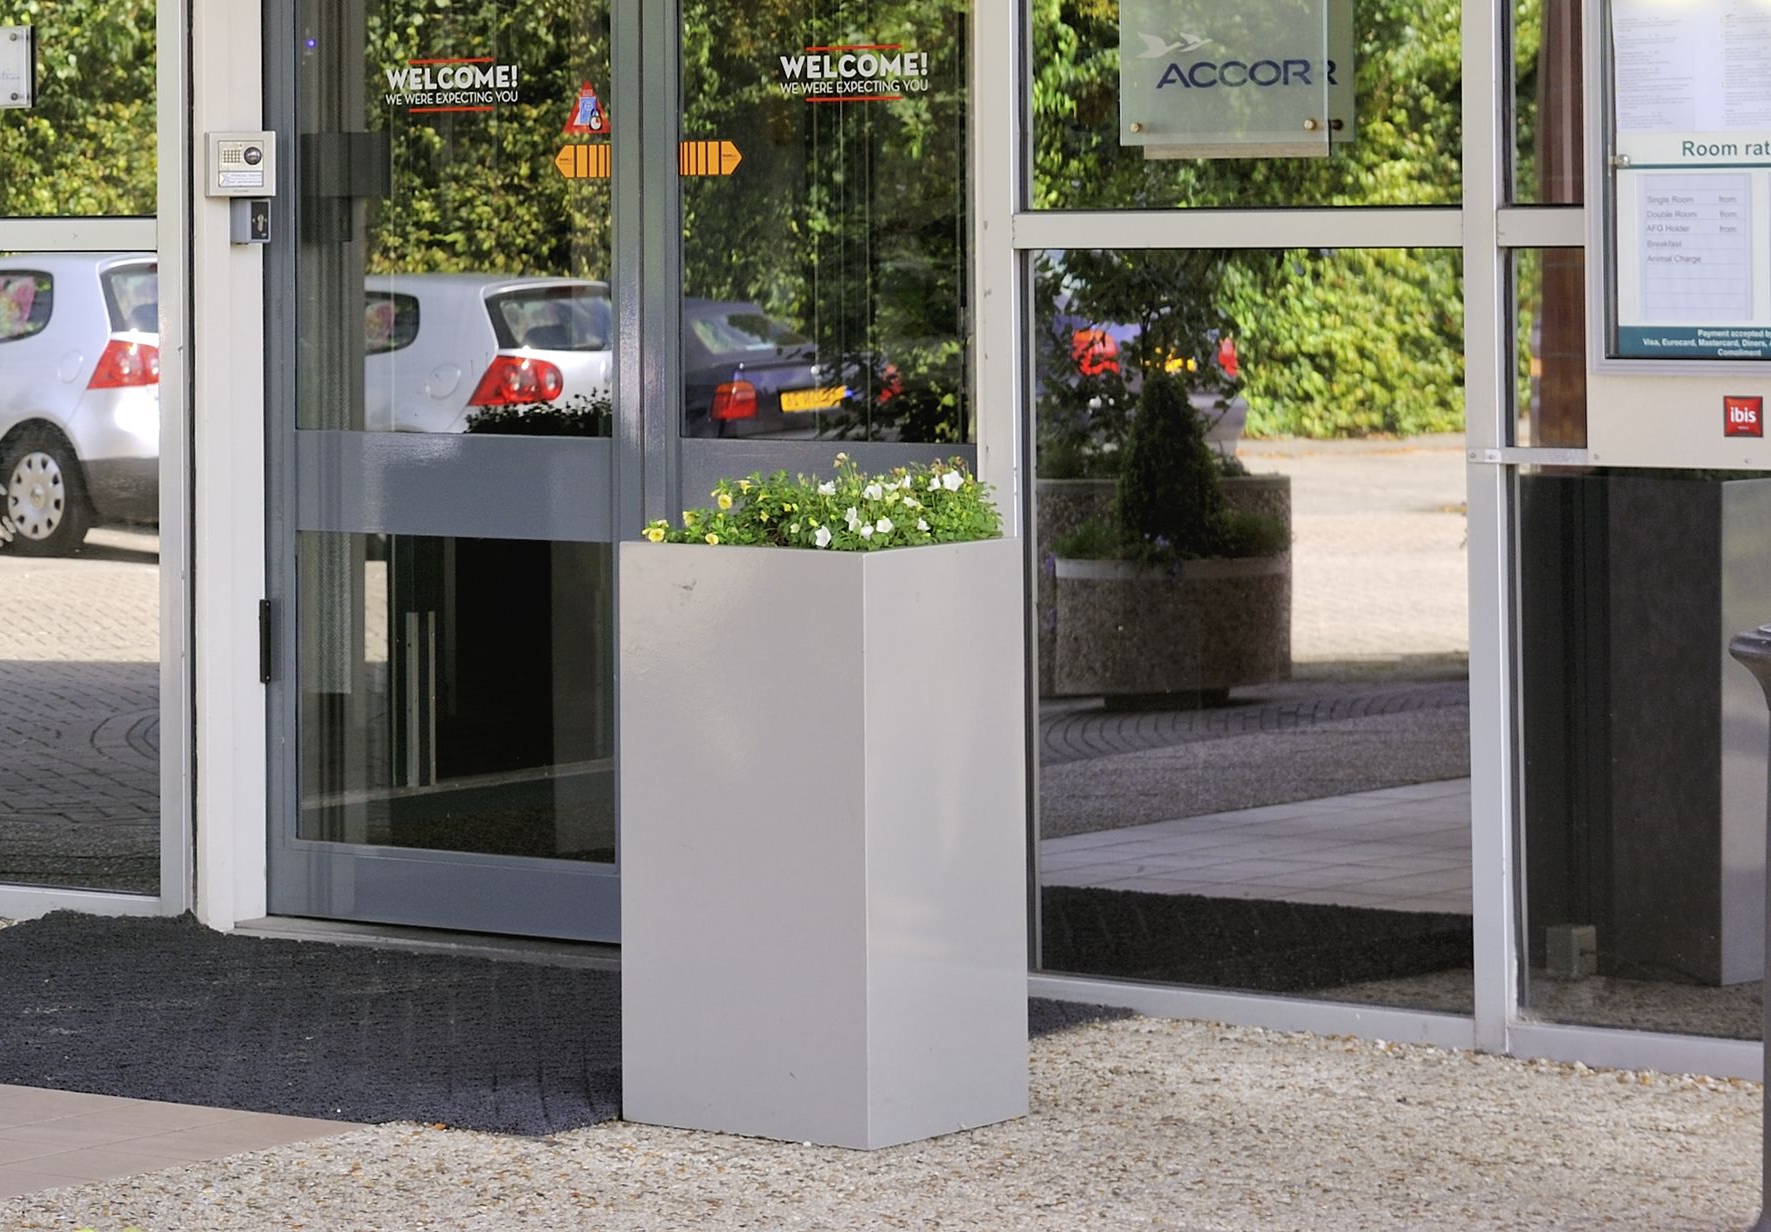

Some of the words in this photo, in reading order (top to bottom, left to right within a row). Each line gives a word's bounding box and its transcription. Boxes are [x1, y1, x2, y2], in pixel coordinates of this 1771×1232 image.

[780, 52, 928, 79] WELCOME!
[385, 65, 519, 91] WELCOME!
[1155, 58, 1313, 90] ACCOR
[780, 82, 799, 95] WE
[801, 81, 834, 94] WERE
[836, 80, 900, 93] EXPECTING
[902, 78, 929, 92] YOU
[385, 94, 403, 106] WE
[404, 93, 433, 105] WERE
[435, 91, 493, 104] EXPECTING
[495, 90, 519, 103] YOU
[1682, 140, 1738, 157] Room
[1647, 196, 1670, 205] Single
[1671, 195, 1695, 203] Room
[1646, 210, 1673, 218] Double
[1675, 210, 1698, 218] Room
[1646, 239, 1682, 248] Breakfast
[1646, 254, 1672, 263] Animal
[1673, 254, 1702, 264] Charge
[1697, 329, 1730, 339] Payment
[1730, 329, 1764, 339] accepted
[1730, 406, 1757, 424] ibis
